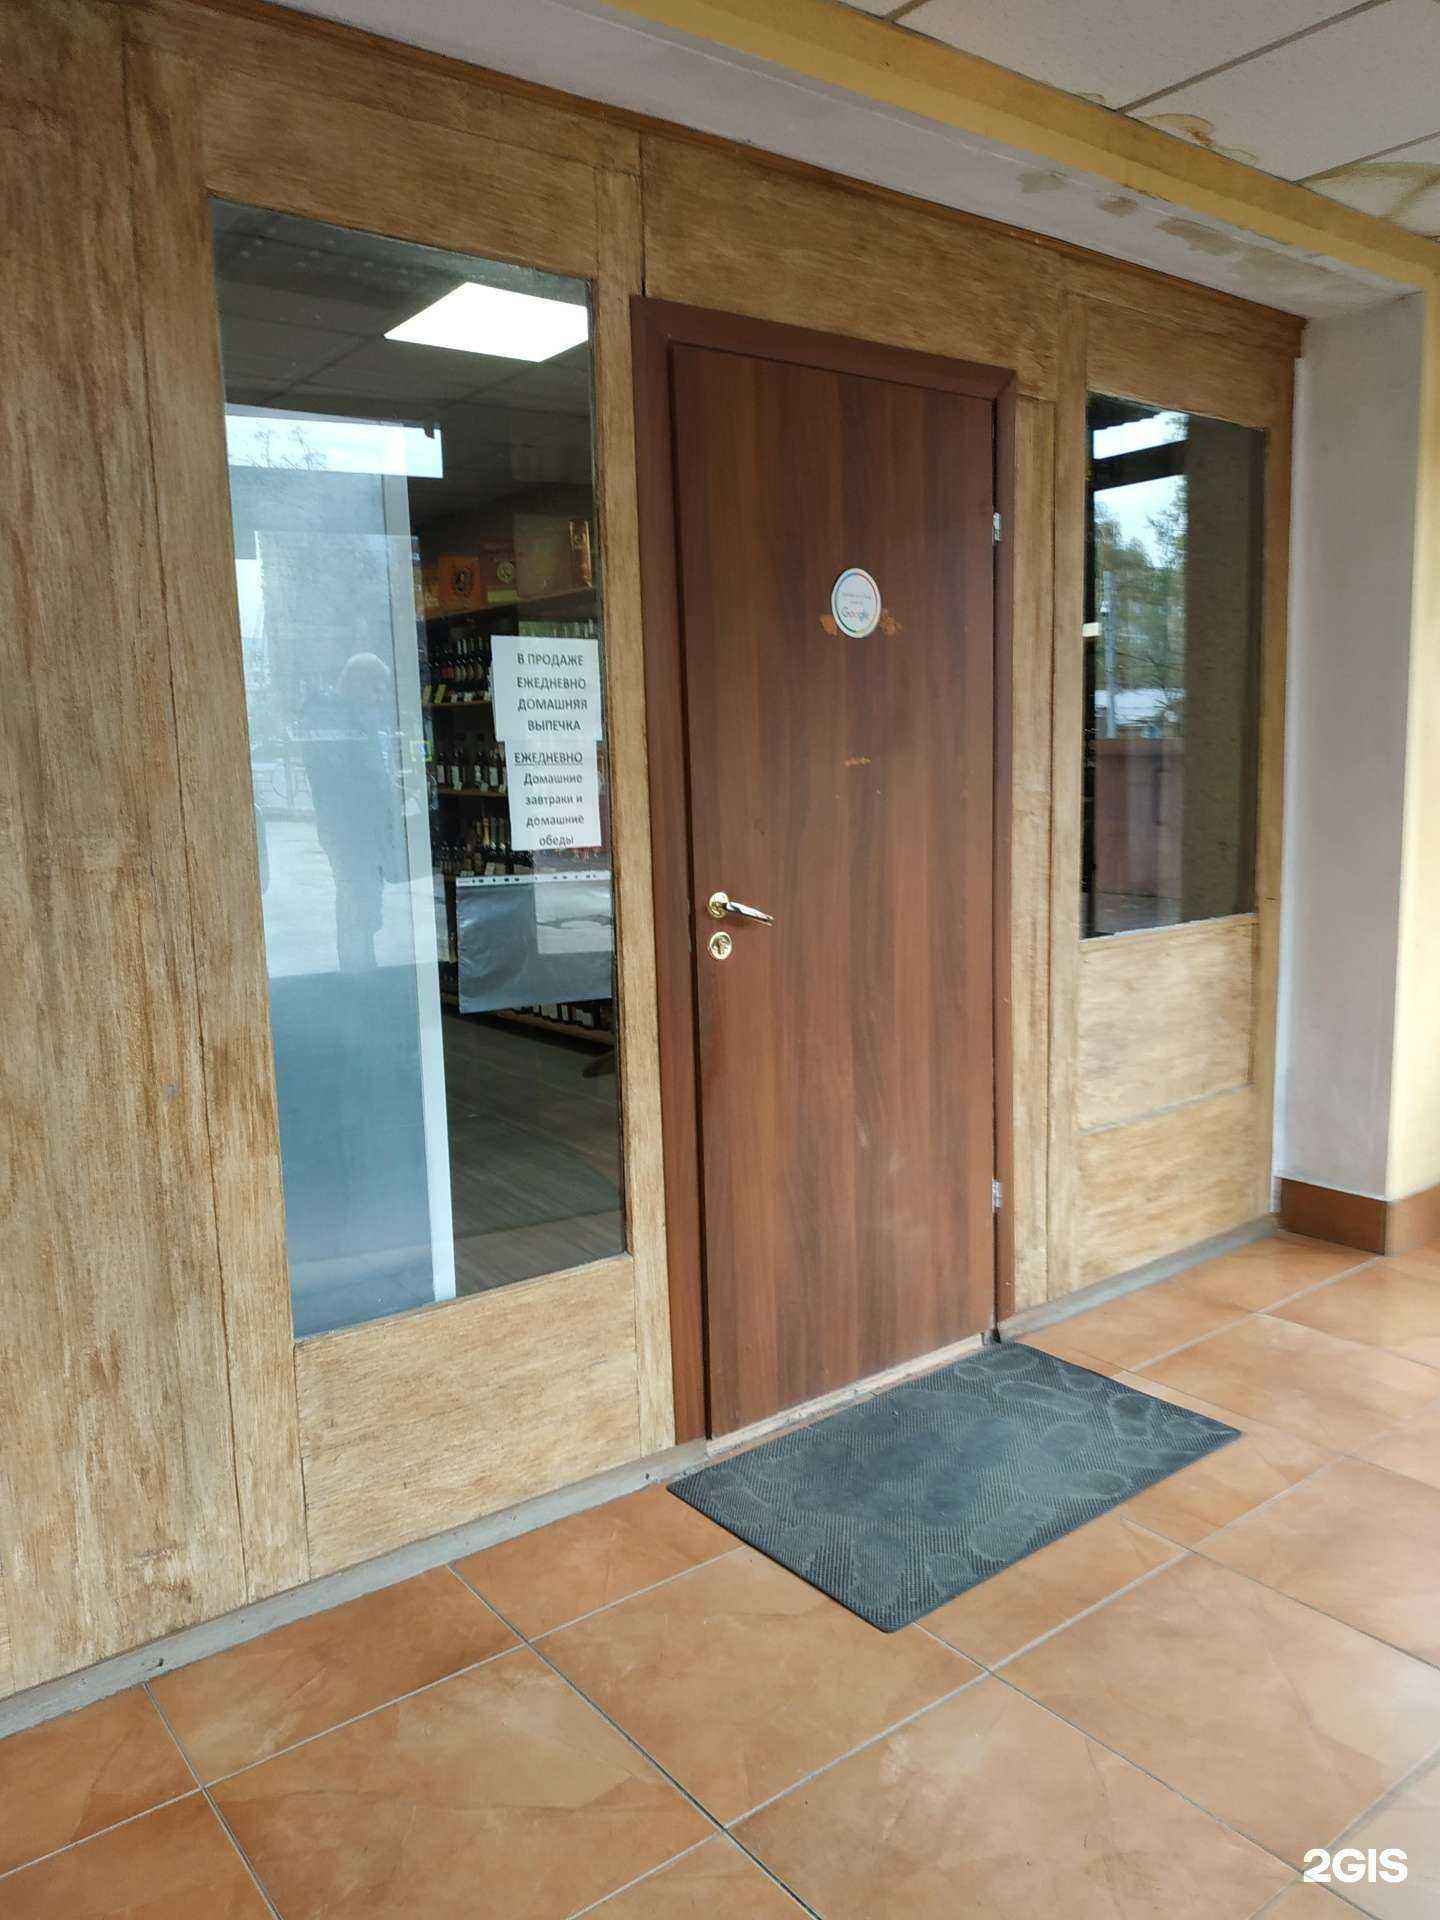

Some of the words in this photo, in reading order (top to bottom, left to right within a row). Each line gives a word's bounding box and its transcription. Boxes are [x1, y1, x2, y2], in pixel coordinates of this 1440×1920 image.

[517, 653, 525, 665] В
[527, 653, 584, 667] ПРОДАЖЕ
[517, 677, 587, 691] ЕЖЕДНЕВНО
[517, 698, 588, 712] ДОМАШНЯЯ
[527, 719, 581, 732] ВЫПЕЧКА
[514, 752, 583, 765] ЕЖЕДНЕВНО
[523, 773, 583, 785] Домашние
[525, 796, 574, 807] завтраки
[576, 796, 583, 804] и
[526, 815, 585, 828] домашние
[539, 834, 574, 848] обеды
